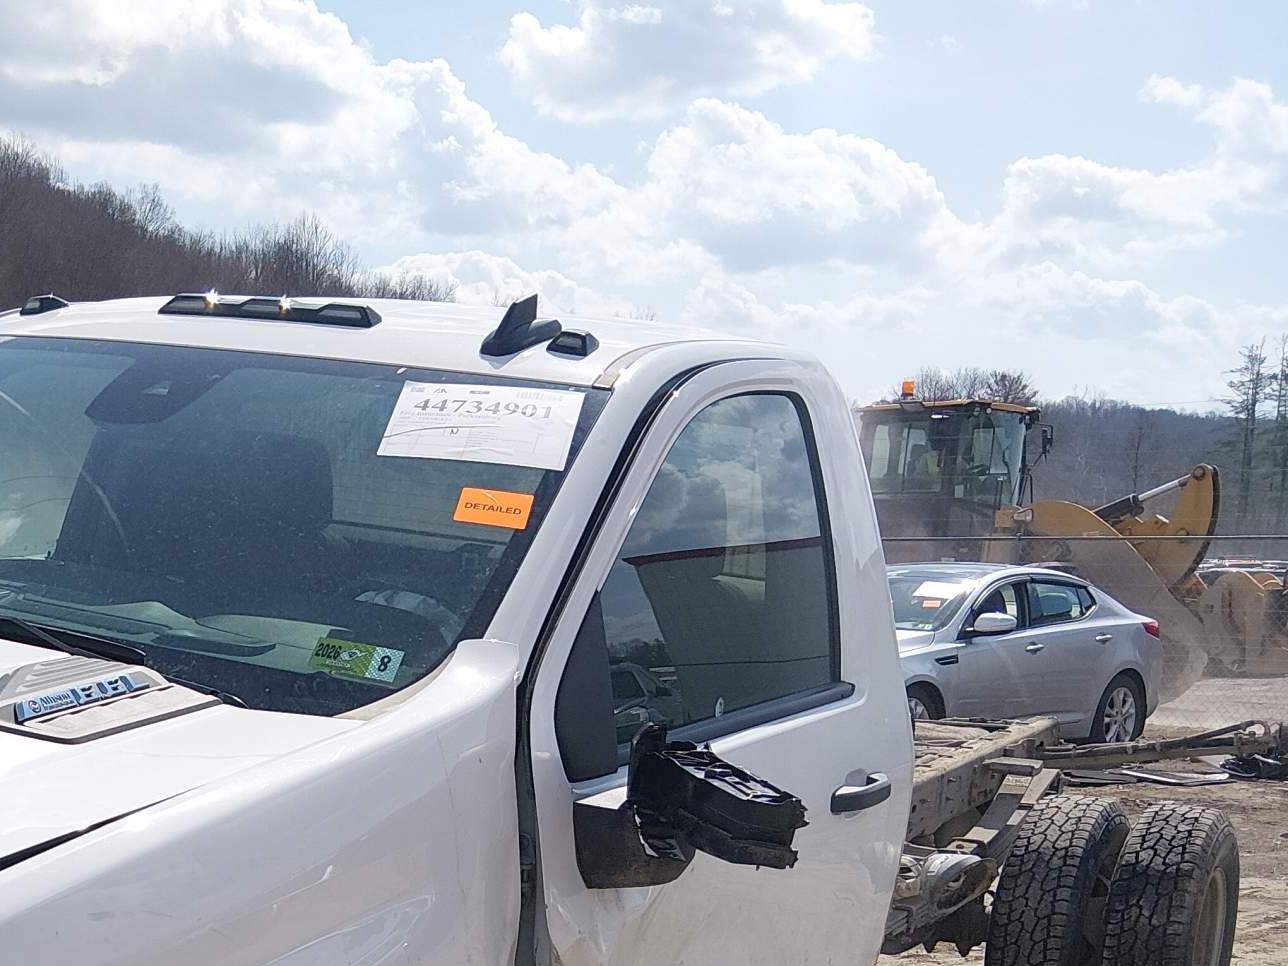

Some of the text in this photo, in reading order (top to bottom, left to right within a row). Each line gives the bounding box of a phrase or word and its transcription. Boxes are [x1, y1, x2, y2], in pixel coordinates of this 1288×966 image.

[414, 399, 552, 419] 44734901
[464, 502, 522, 516] DETAILED
[314, 643, 342, 660] 2026
[377, 655, 392, 672] 8
[39, 693, 71, 705] Allison
